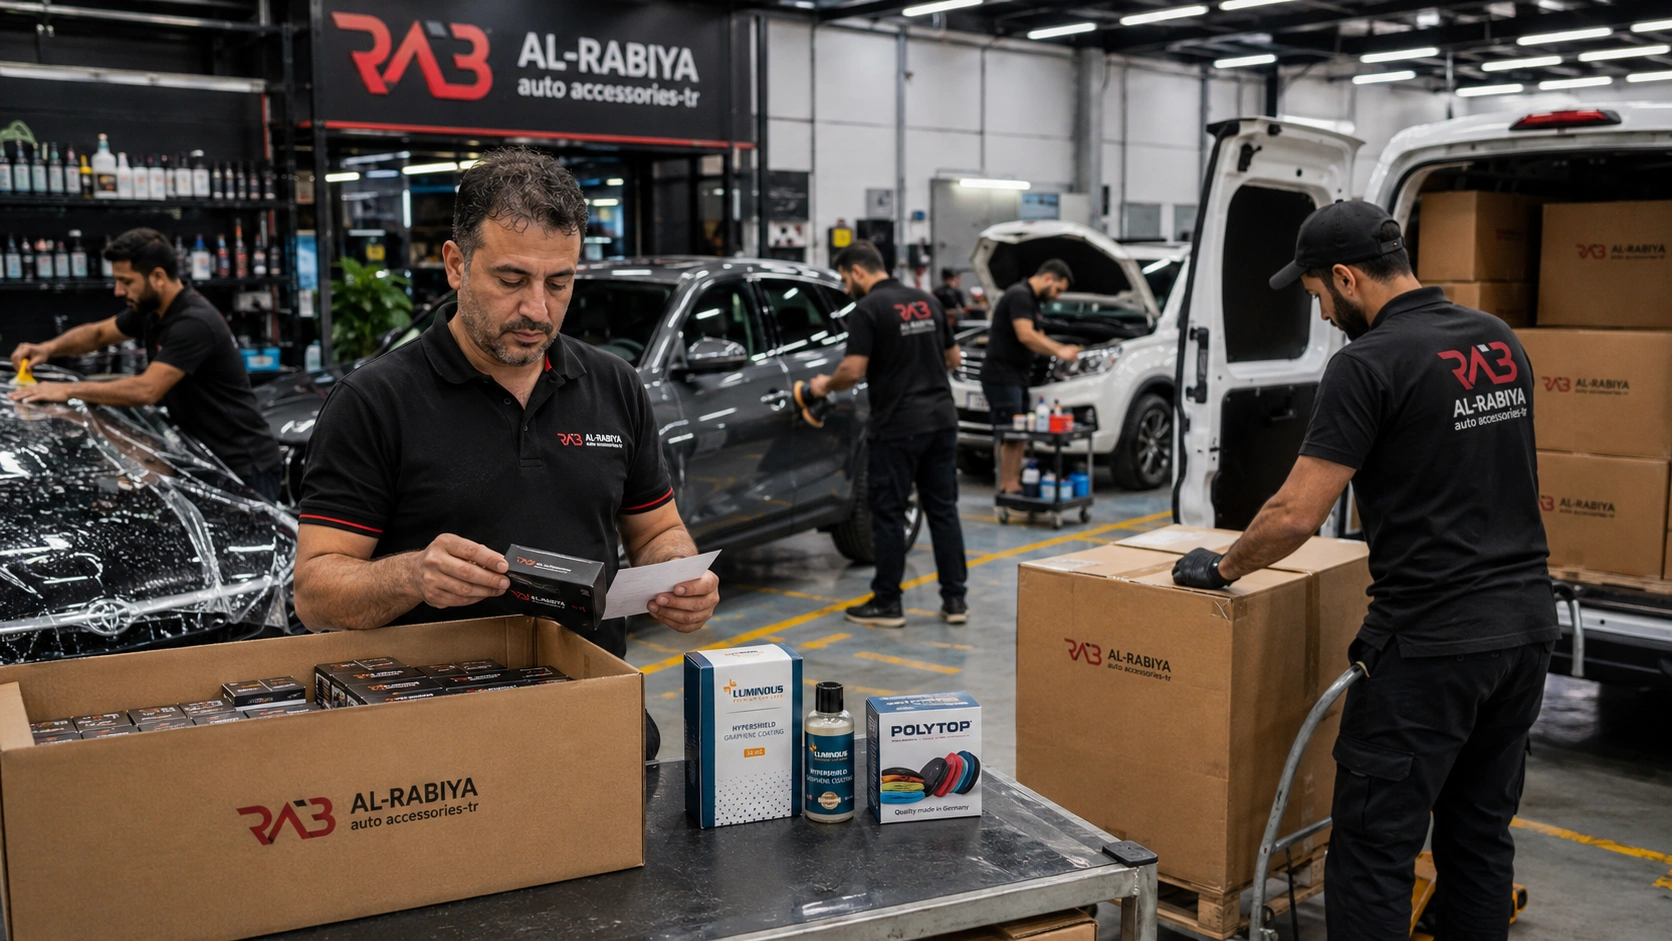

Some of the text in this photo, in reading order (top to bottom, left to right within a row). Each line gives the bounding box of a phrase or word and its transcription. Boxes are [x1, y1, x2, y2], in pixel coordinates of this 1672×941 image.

[517, 32, 700, 83] AL-RABIYA
[517, 76, 701, 108] auto accessories-tr
[1453, 387, 1527, 418] AL-RABIYA
[1454, 417, 1477, 431] auto
[1107, 648, 1172, 673] AL-RABIYA
[732, 684, 784, 698] LUMINOUS
[890, 720, 973, 737] POLYTOP
[350, 777, 479, 815] AL-RABIYA
[350, 801, 479, 831] auto accessories-tr
